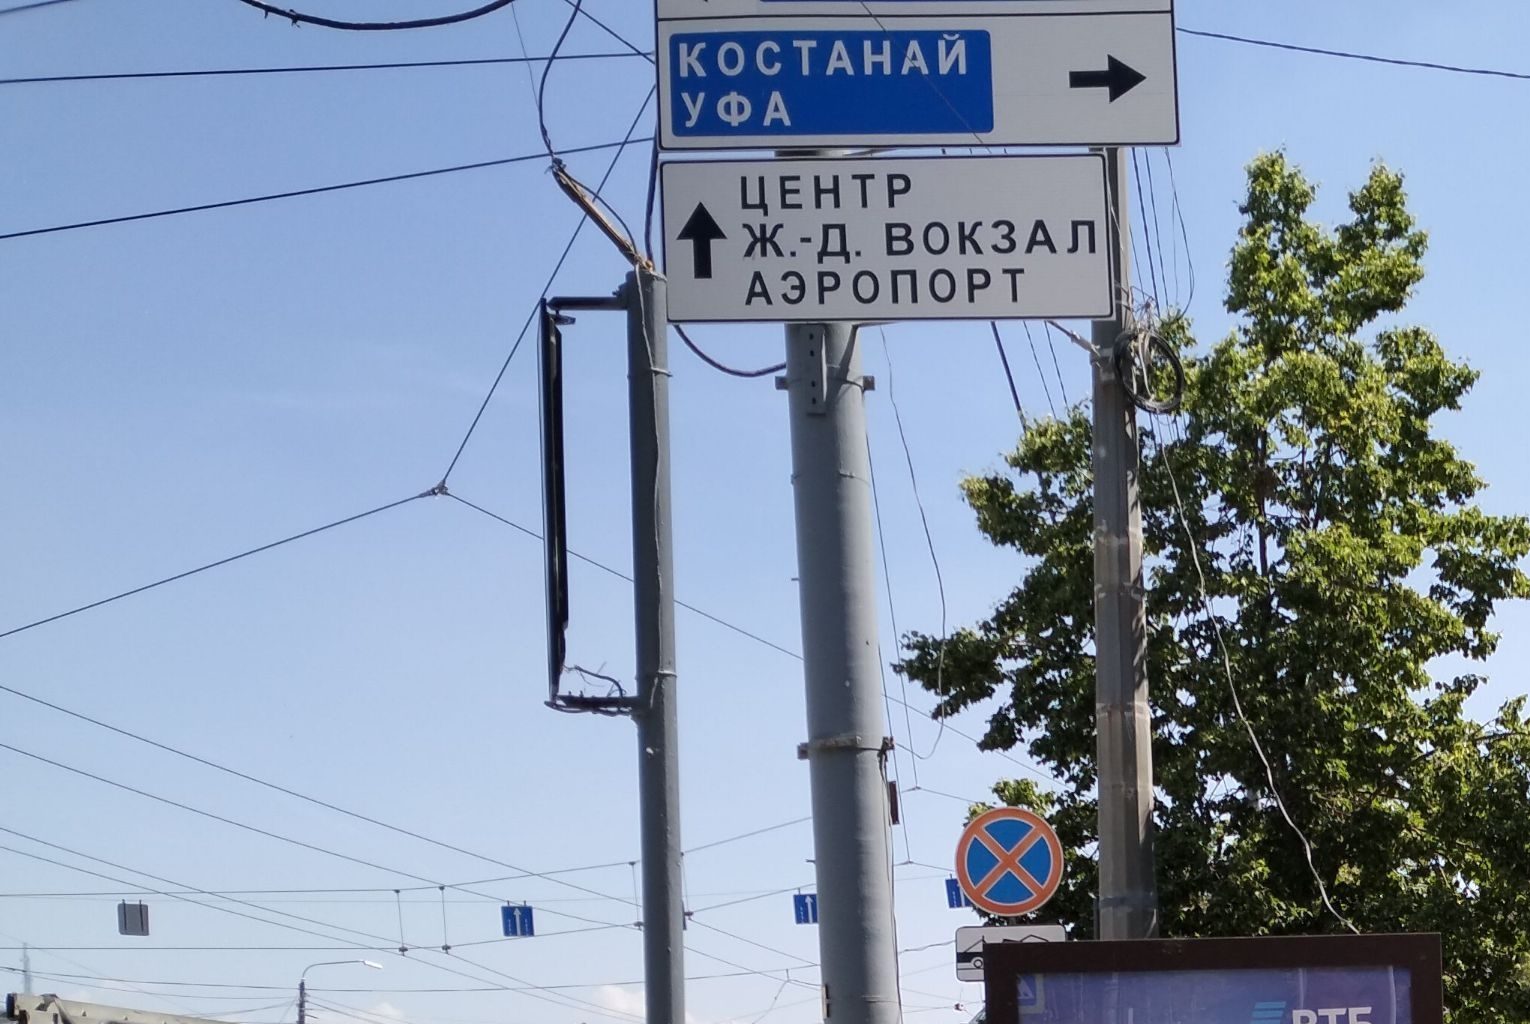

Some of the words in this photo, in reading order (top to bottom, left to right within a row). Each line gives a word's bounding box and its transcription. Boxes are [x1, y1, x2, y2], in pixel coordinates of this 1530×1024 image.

[679, 33, 968, 77] КОСТАНАЙ
[680, 90, 792, 128] УФА
[740, 173, 913, 216] ЦЕНТР
[742, 221, 863, 264] Ж.-Д.
[885, 219, 1098, 257] ВОКЗАЛ
[744, 267, 1026, 306] АЭРОПОРТ
